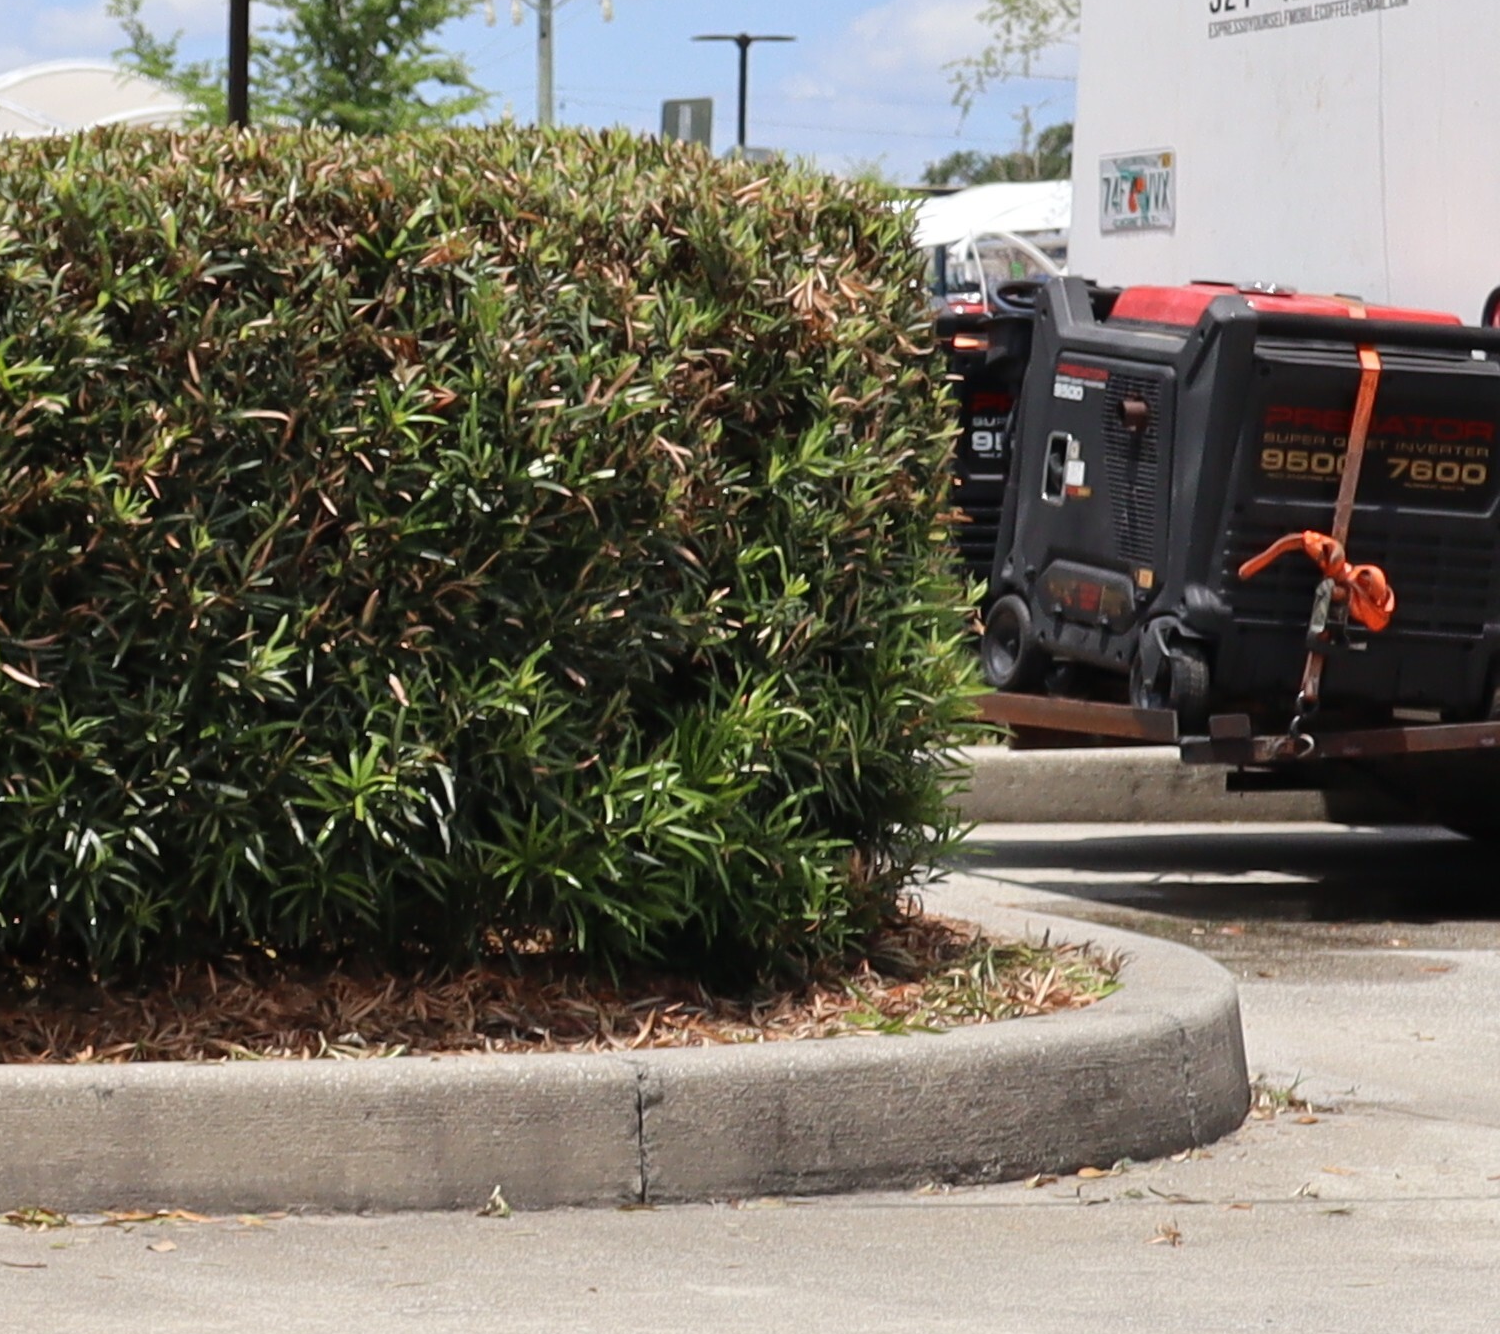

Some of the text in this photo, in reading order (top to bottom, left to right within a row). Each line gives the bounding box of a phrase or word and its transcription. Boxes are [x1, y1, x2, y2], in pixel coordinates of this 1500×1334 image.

[1264, 406, 1495, 443] PREATOR
[1263, 432, 1490, 458] SUPER QET INVERTER
[1387, 457, 1487, 485] 7600
